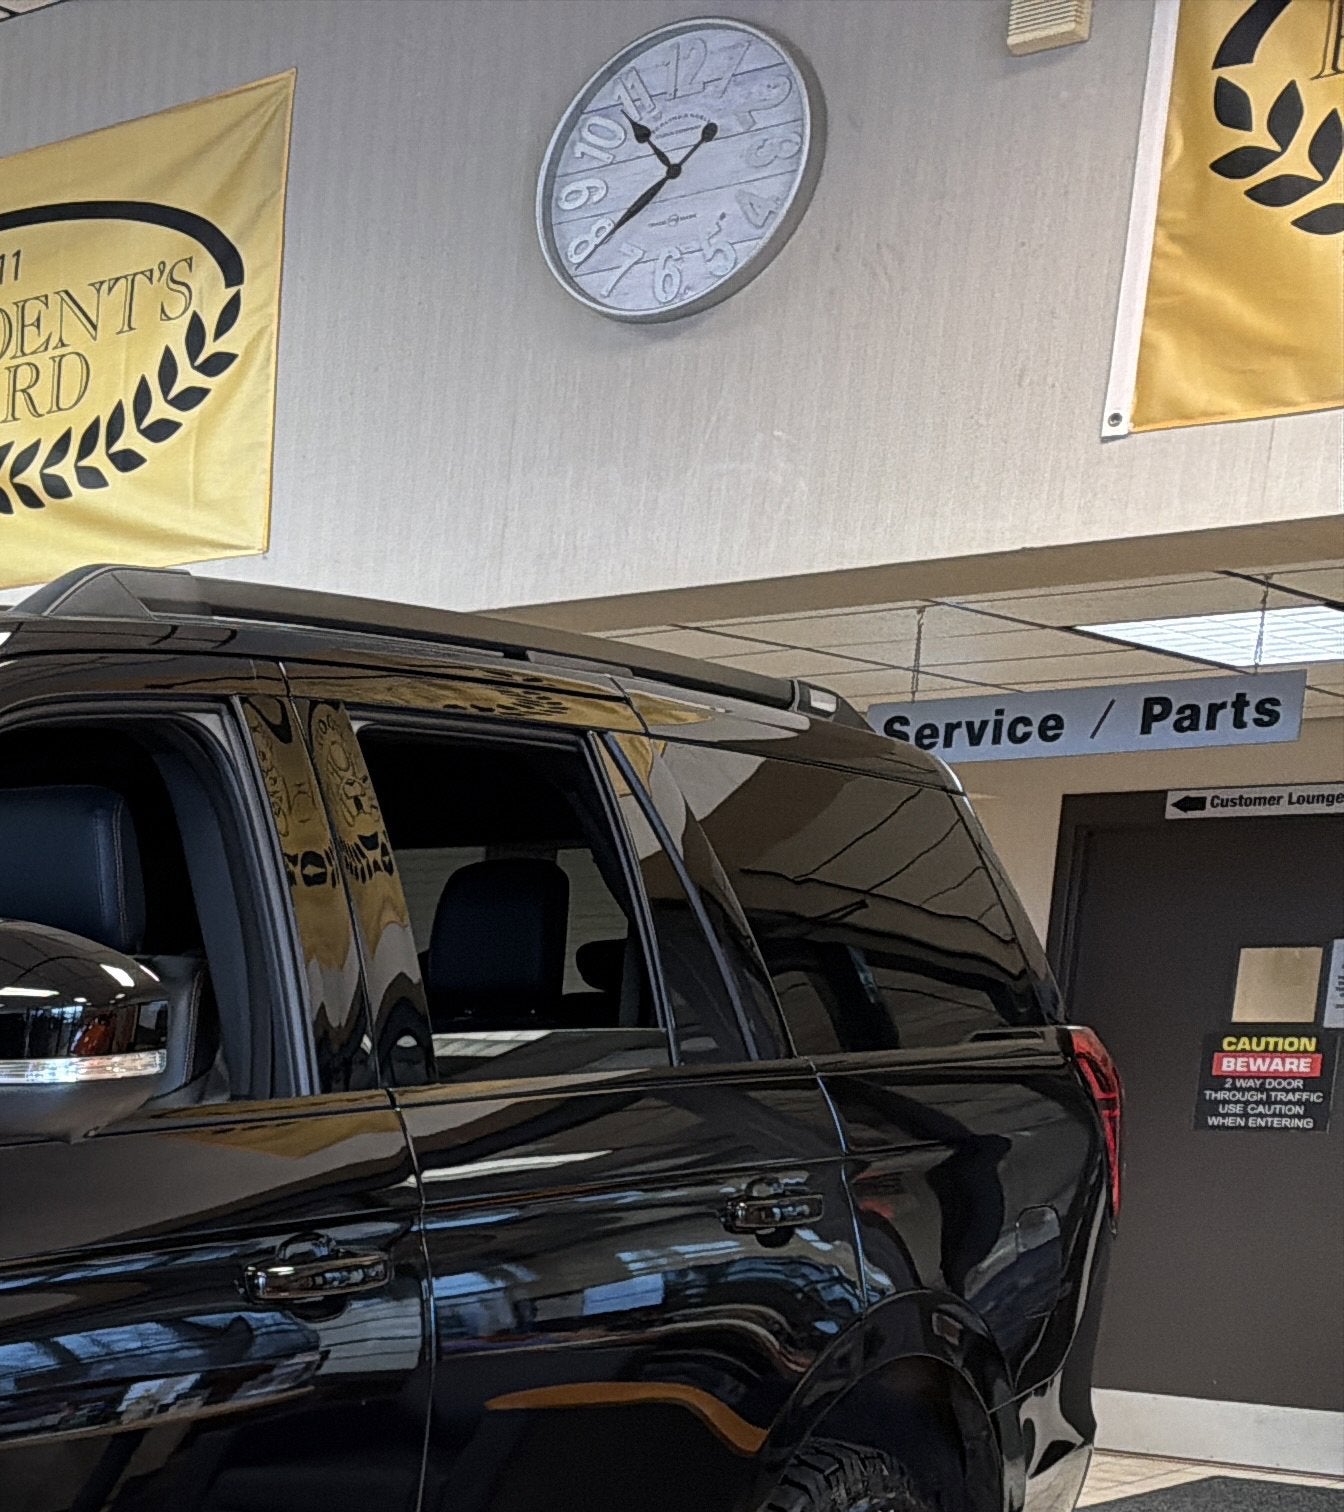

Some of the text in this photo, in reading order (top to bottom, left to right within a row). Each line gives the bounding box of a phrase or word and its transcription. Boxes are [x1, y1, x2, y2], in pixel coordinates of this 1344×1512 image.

[661, 37, 708, 101] 12
[616, 66, 657, 121] 11
[573, 115, 627, 163] 10
[557, 177, 608, 211] 9
[565, 216, 616, 264] 8
[652, 245, 683, 304] 6
[883, 707, 1065, 751] Service
[1139, 691, 1283, 736] Parts
[1209, 790, 1344, 809] Customer Lounge
[1221, 1036, 1317, 1052] CAUTION
[1221, 1057, 1313, 1073] BEWARE
[1204, 1090, 1324, 1103] THROUGH TRAFFIC
[1224, 1078, 1304, 1090] 2 WAY DOOR
[1207, 1116, 1314, 1129] WHEN ENTERING
[1218, 1104, 1305, 1116] USE CAUTION
